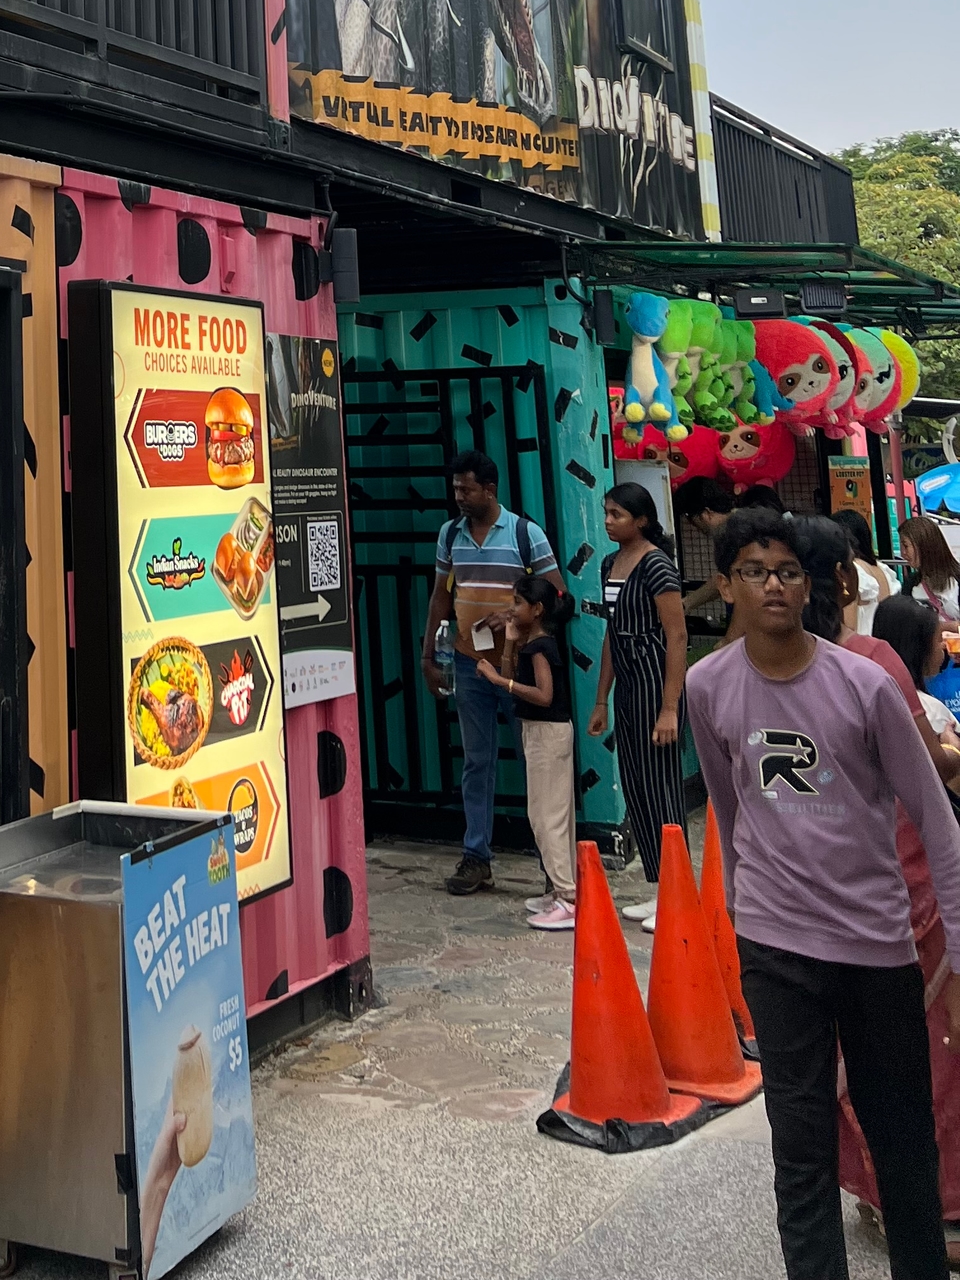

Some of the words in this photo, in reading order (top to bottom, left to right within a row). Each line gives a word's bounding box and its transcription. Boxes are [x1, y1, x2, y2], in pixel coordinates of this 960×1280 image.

[134, 307, 191, 350] MORE
[198, 315, 247, 355] FOOD
[144, 351, 188, 373] CHOICES
[191, 355, 241, 377] AVAILABLE
[145, 423, 197, 445] BURERS
[153, 557, 175, 573] Indian
[174, 554, 199, 571] Snacks
[231, 690, 248, 725] PIT
[234, 827, 255, 846] WRAPS
[133, 874, 187, 975] BEAT
[145, 934, 186, 1013] THE
[185, 903, 231, 967] HEAT
[220, 993, 240, 1020] FRESH
[212, 1011, 240, 1042] COCONUT
[228, 1035, 243, 1072] $5
